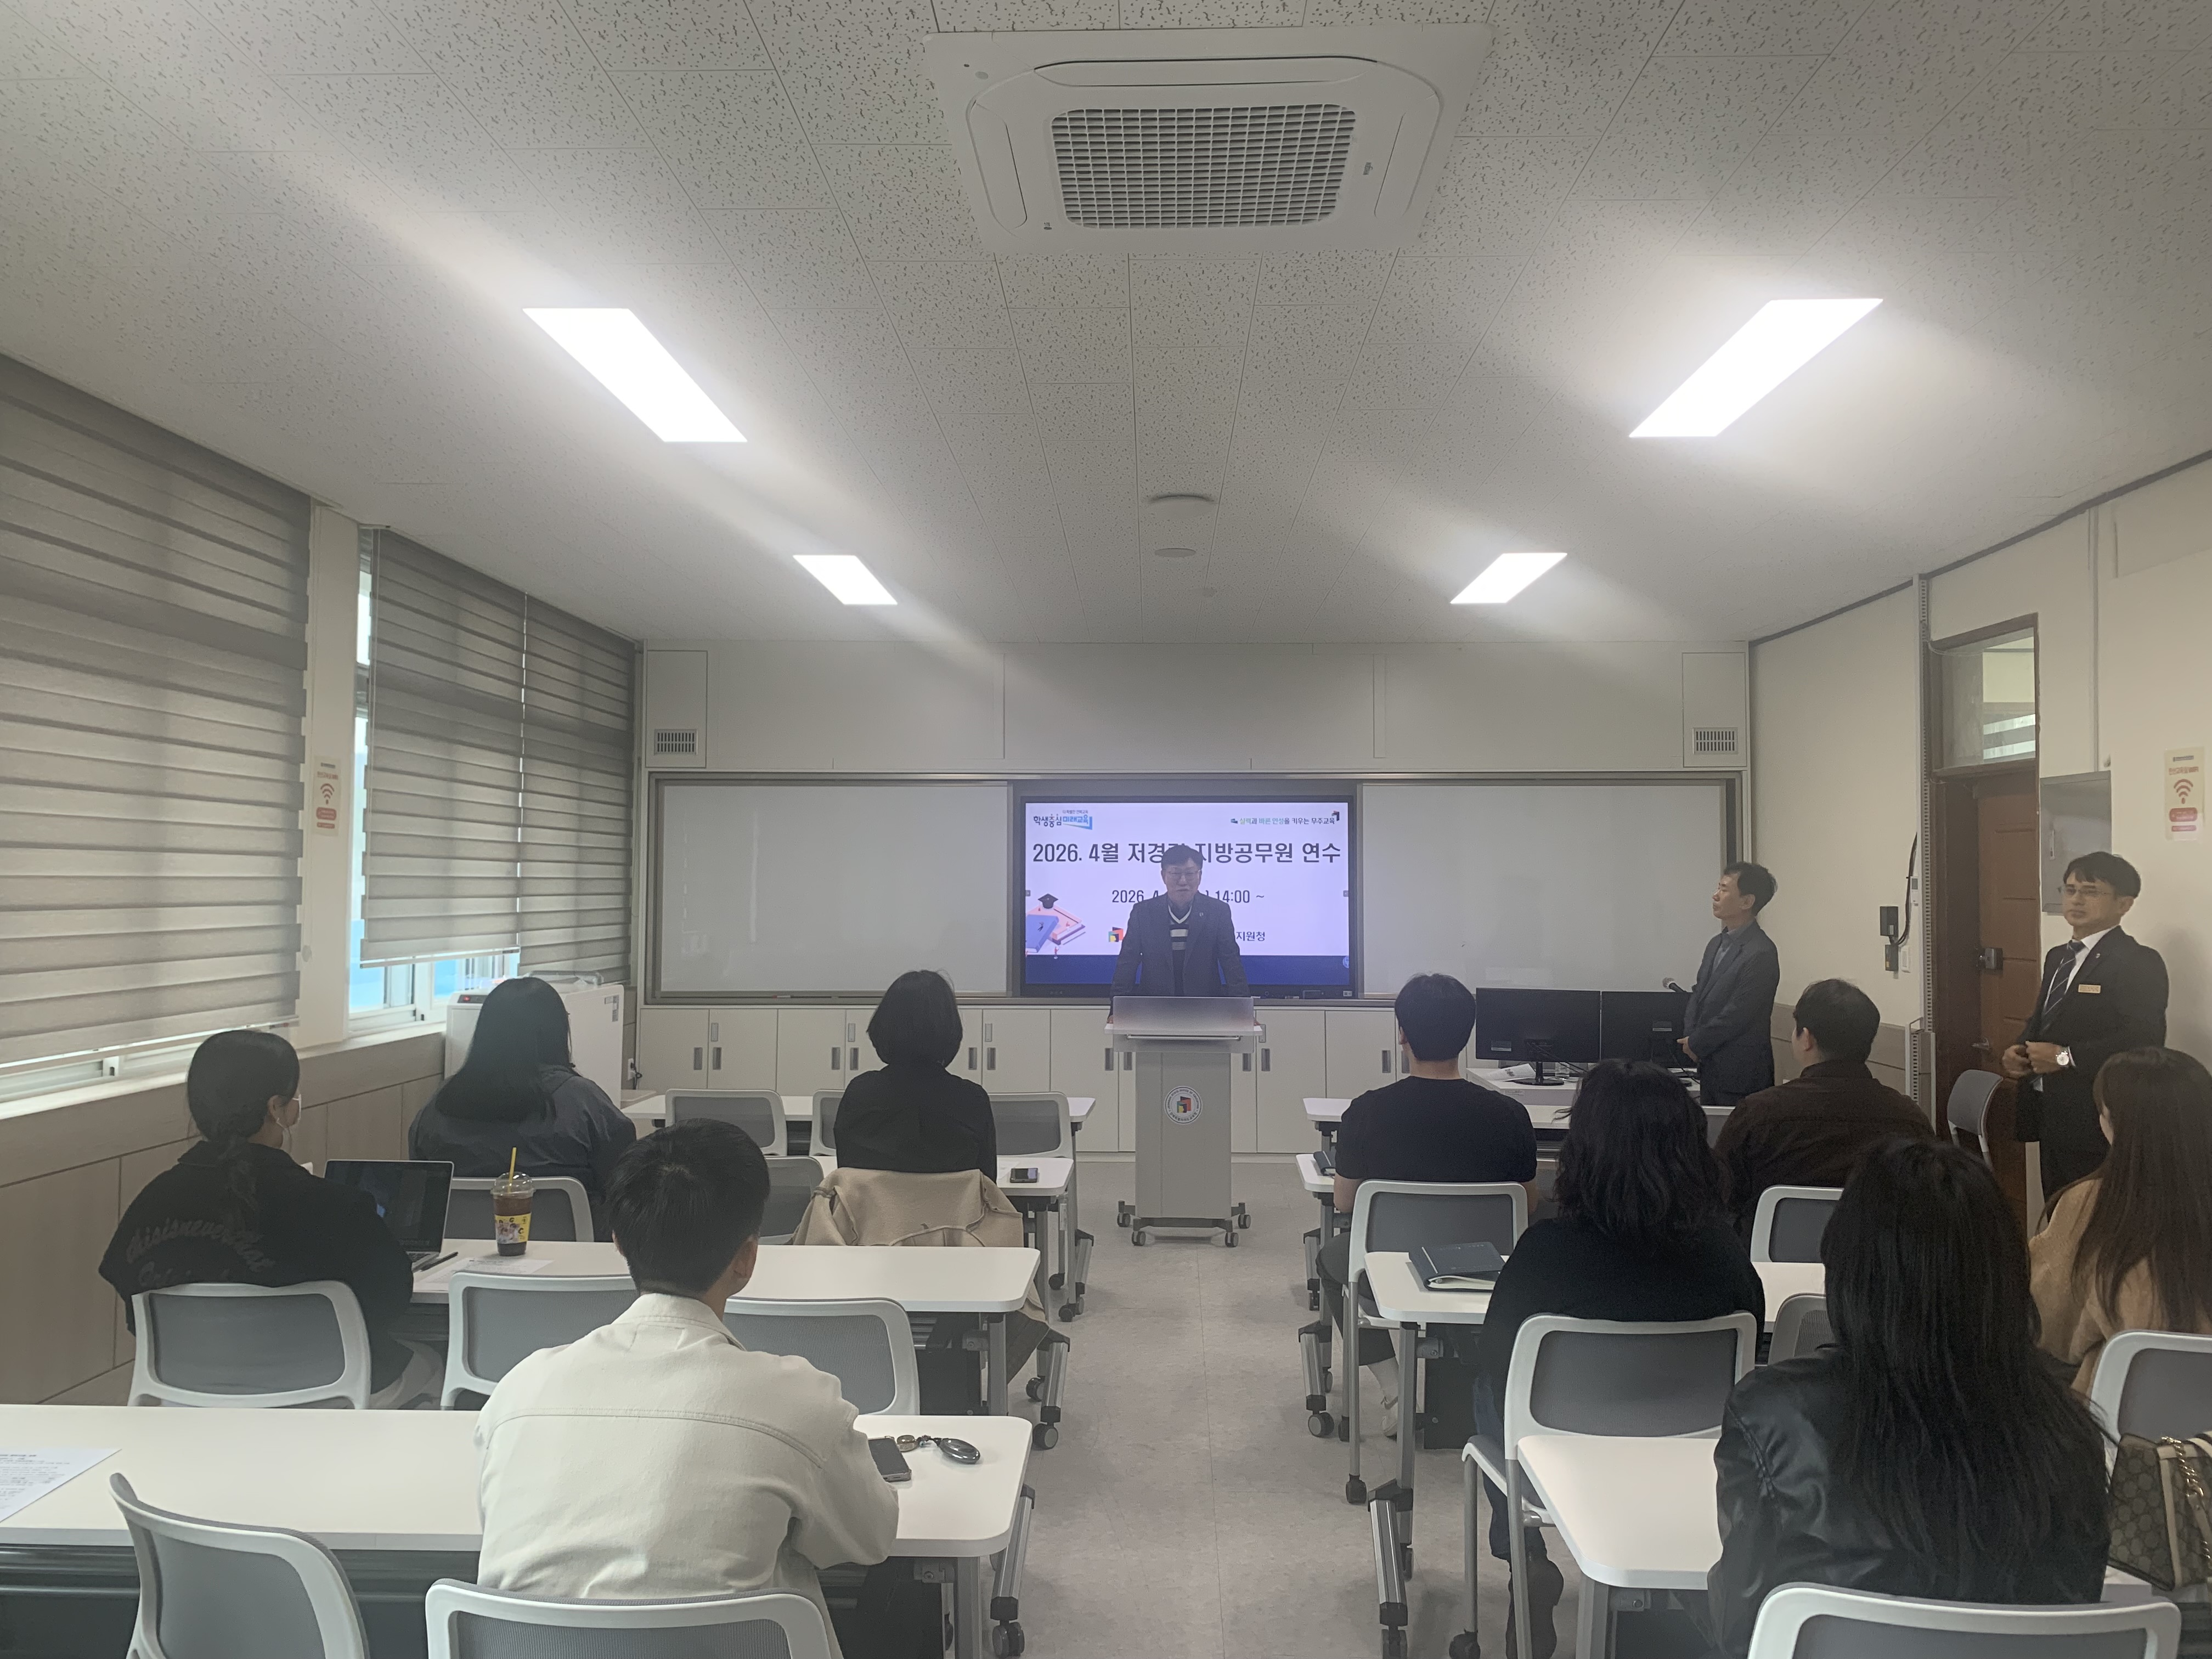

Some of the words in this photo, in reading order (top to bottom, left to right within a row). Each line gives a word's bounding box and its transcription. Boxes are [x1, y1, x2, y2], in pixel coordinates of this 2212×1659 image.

[1033, 814, 1062, 828] 학생중심
[1062, 814, 1088, 825] 미래교육
[1033, 843, 1082, 862] 2026.
[1088, 843, 1119, 863] 4월
[1127, 843, 1185, 864] 저경
[1195, 843, 1293, 864] 지방공무원
[1302, 843, 1341, 863] 연수
[1215, 890, 1250, 903] 14:00
[1236, 931, 1265, 941] 지원청
